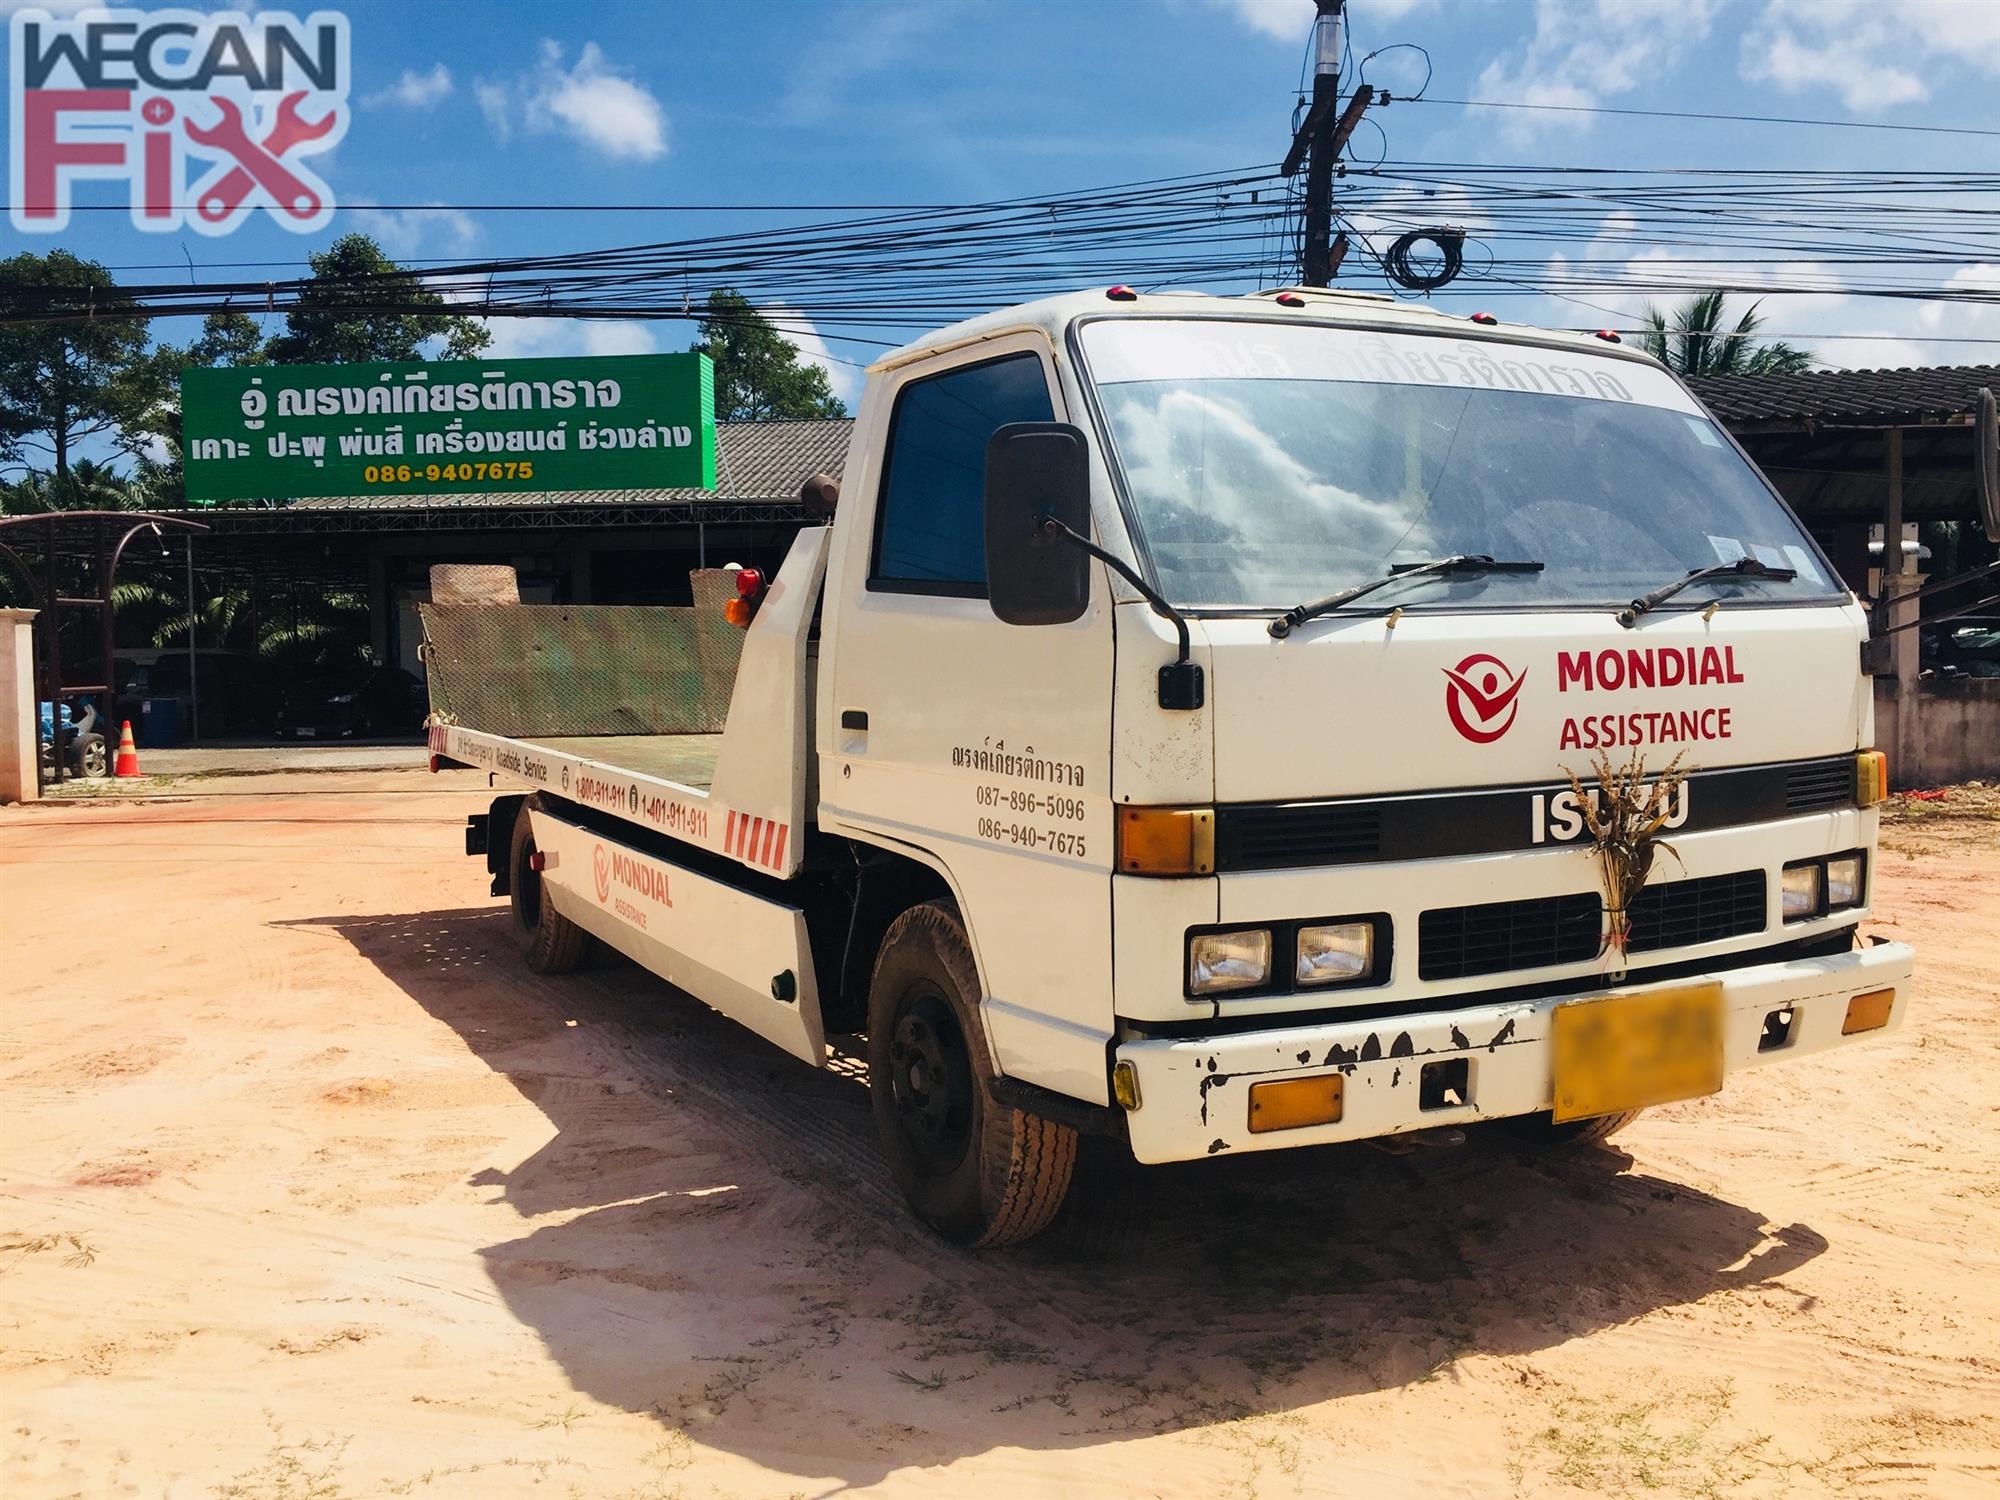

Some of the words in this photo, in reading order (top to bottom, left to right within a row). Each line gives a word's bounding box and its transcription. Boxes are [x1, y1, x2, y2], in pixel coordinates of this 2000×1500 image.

[241, 378, 267, 430] อู่
[277, 371, 621, 416] ณรงค์เกียรติการาจ
[191, 437, 250, 460] เคาะ
[339, 425, 403, 456] พ่นสี
[416, 418, 567, 454] เครื่องยนต์
[579, 419, 692, 450] ช่วงล่าง
[364, 462, 534, 483] 086-9407675
[1557, 646, 1744, 693] MONDIAL
[1559, 708, 1732, 751] ASSISTANCE
[952, 736, 1085, 788] ณรงค์เกียรติการาจ
[524, 756, 547, 782] Service
[576, 777, 625, 811] 1-800-911-911
[642, 795, 707, 839] 1-401-911-911
[976, 785, 1085, 821] 087-896-5096
[978, 817, 1086, 857] 086-940-7675
[613, 852, 673, 908] MONDIAL
[615, 898, 647, 930] ASSISTANCE
